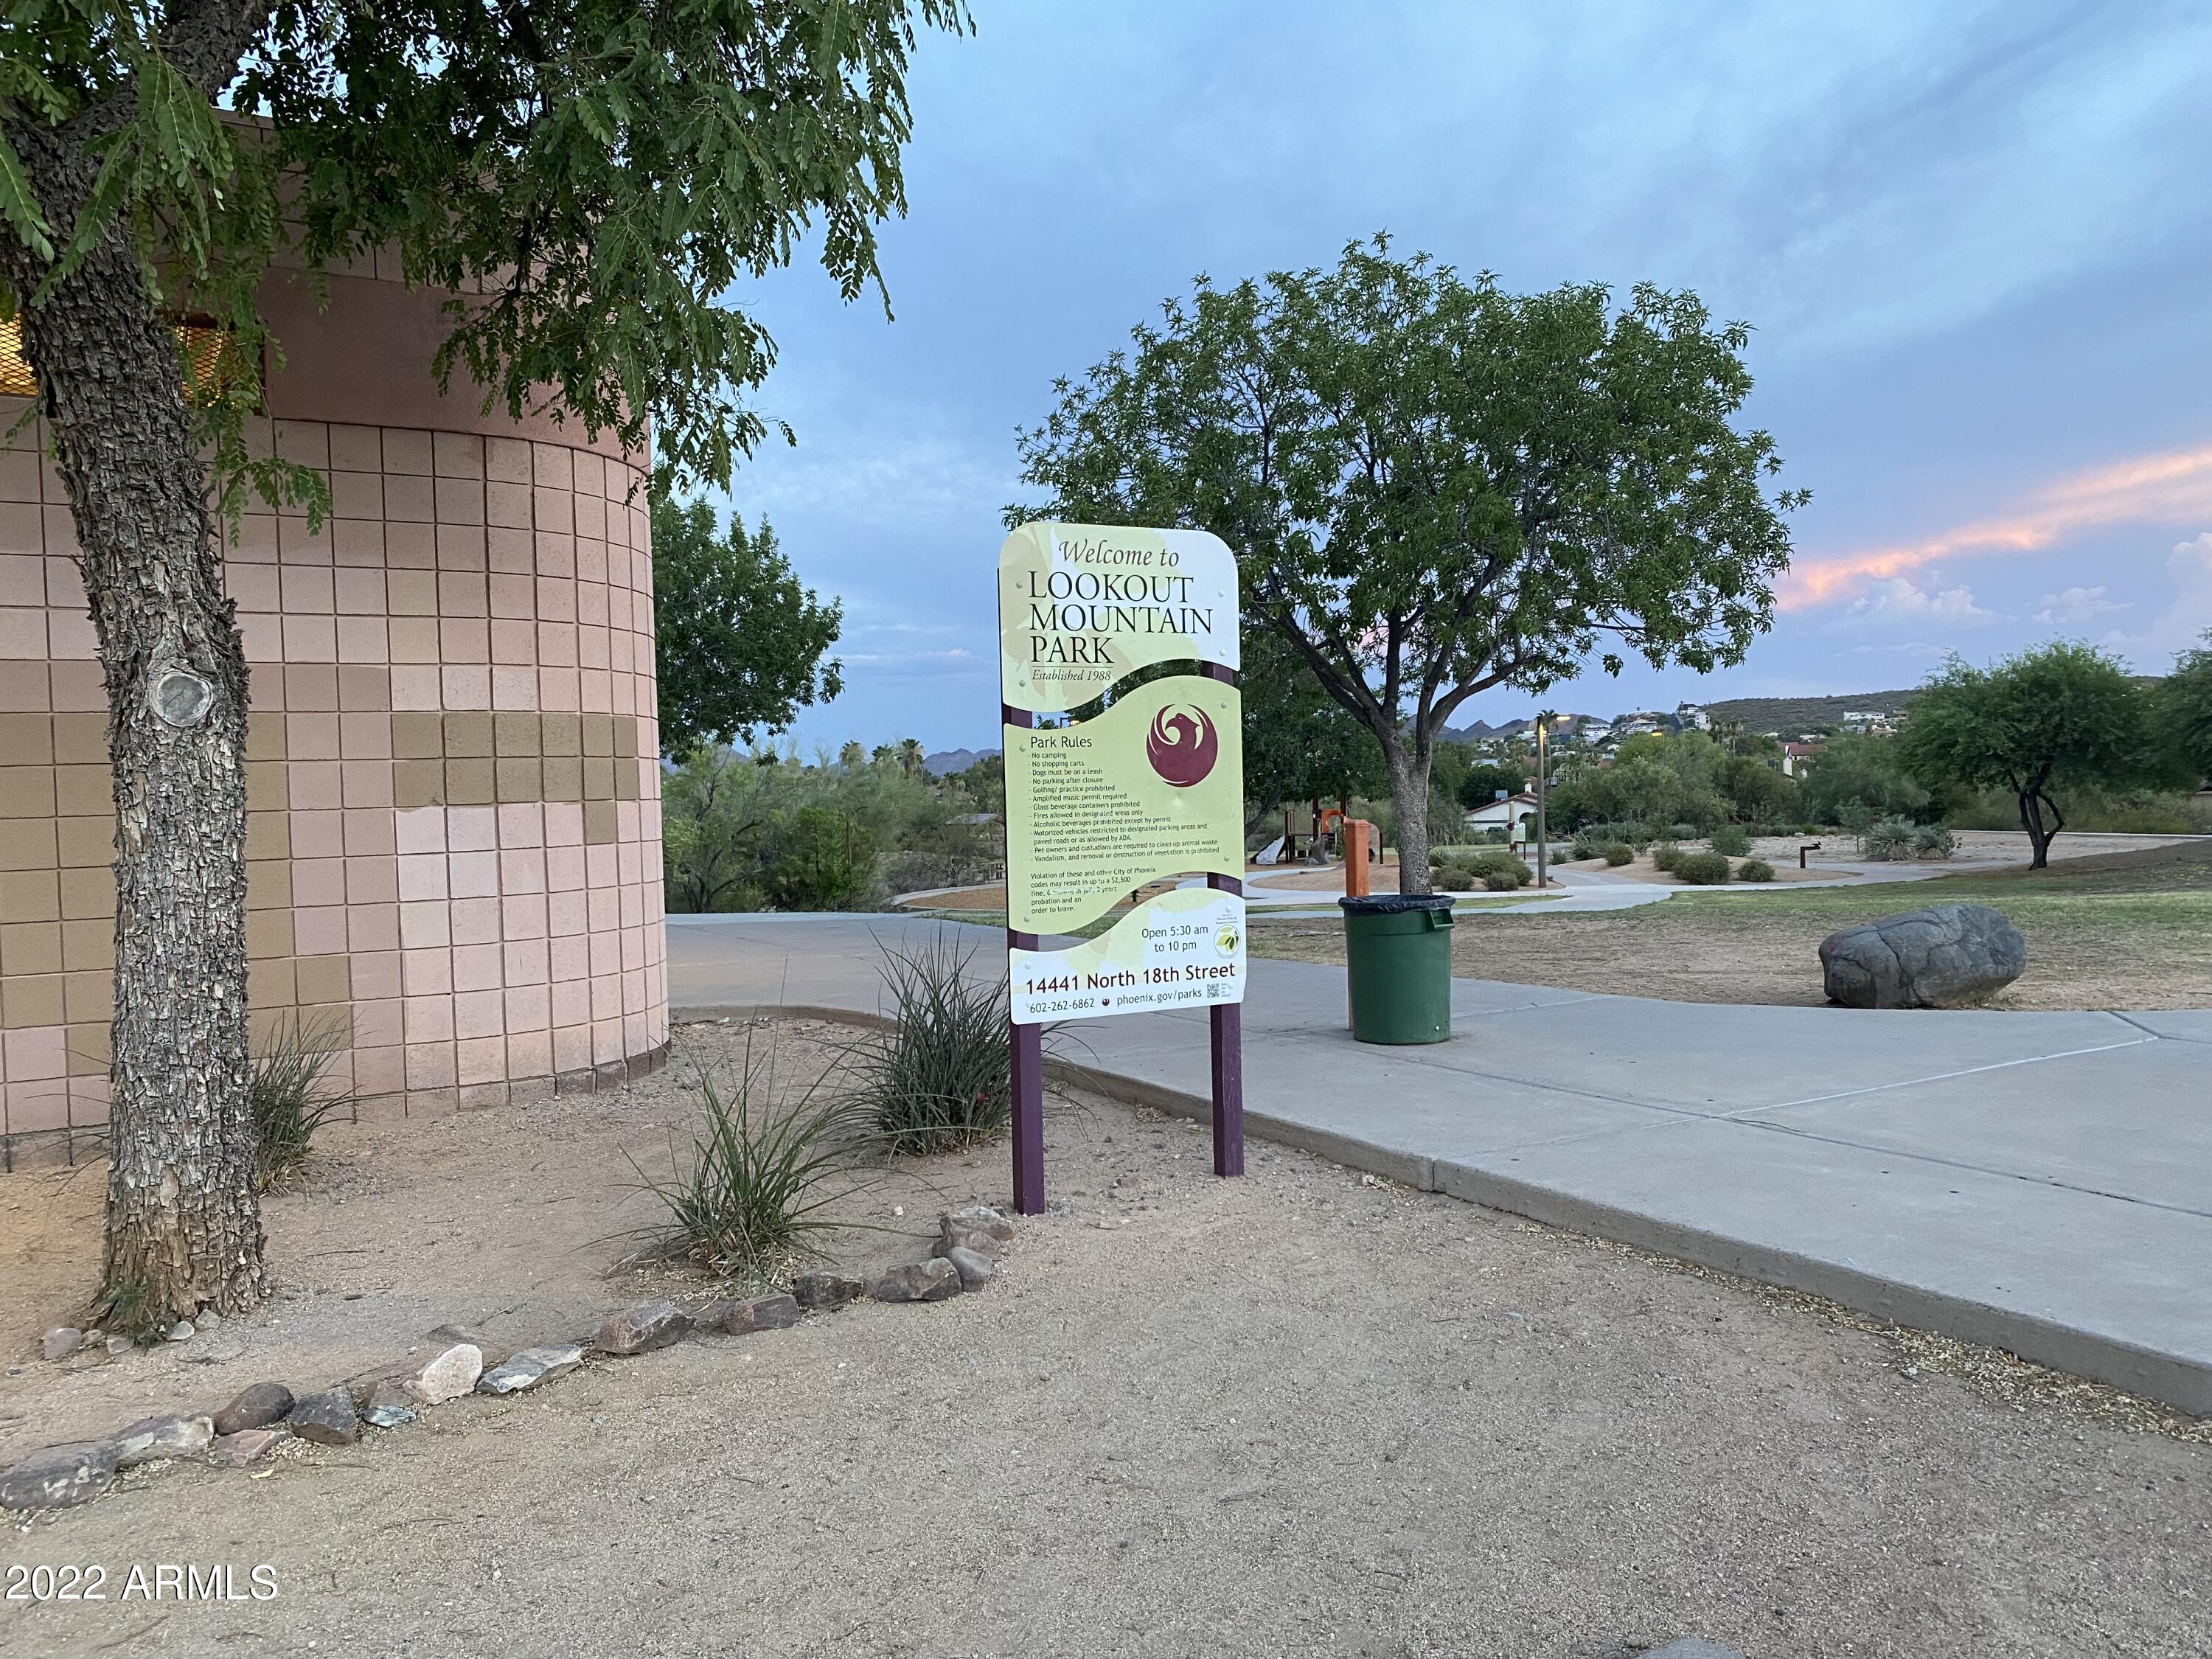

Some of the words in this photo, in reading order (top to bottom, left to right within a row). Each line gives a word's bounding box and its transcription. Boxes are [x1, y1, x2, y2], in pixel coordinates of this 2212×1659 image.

[1058, 538, 1152, 566] Welcome
[1160, 549, 1179, 567] to
[1028, 570, 1194, 603] LOOKOUT
[1029, 603, 1213, 635] MOUNTAIN
[1029, 636, 1115, 664] PARK
[1032, 669, 1084, 681] Established
[1086, 669, 1111, 681] 1988
[1031, 736, 1057, 748] Park
[1061, 736, 1093, 748] Rules
[1033, 795, 1062, 803] Amplified
[1051, 803, 1077, 811] beverage
[1110, 801, 1140, 809] prohibited
[1124, 817, 1143, 825] except
[1034, 838, 1051, 846] paved
[1141, 928, 1167, 940] Open
[1169, 925, 1191, 936] 5:30
[1194, 925, 1208, 934] am
[1155, 942, 1165, 953] to
[1168, 940, 1179, 951] 10
[1182, 941, 1197, 953] pm
[1026, 975, 1079, 995] 14441
[1087, 970, 1135, 990] North
[1143, 966, 1180, 984] 18th
[1186, 962, 1236, 981] Street
[1029, 998, 1095, 1014] 602-262-6862
[1117, 988, 1202, 1007] phoenix.gov/parks
